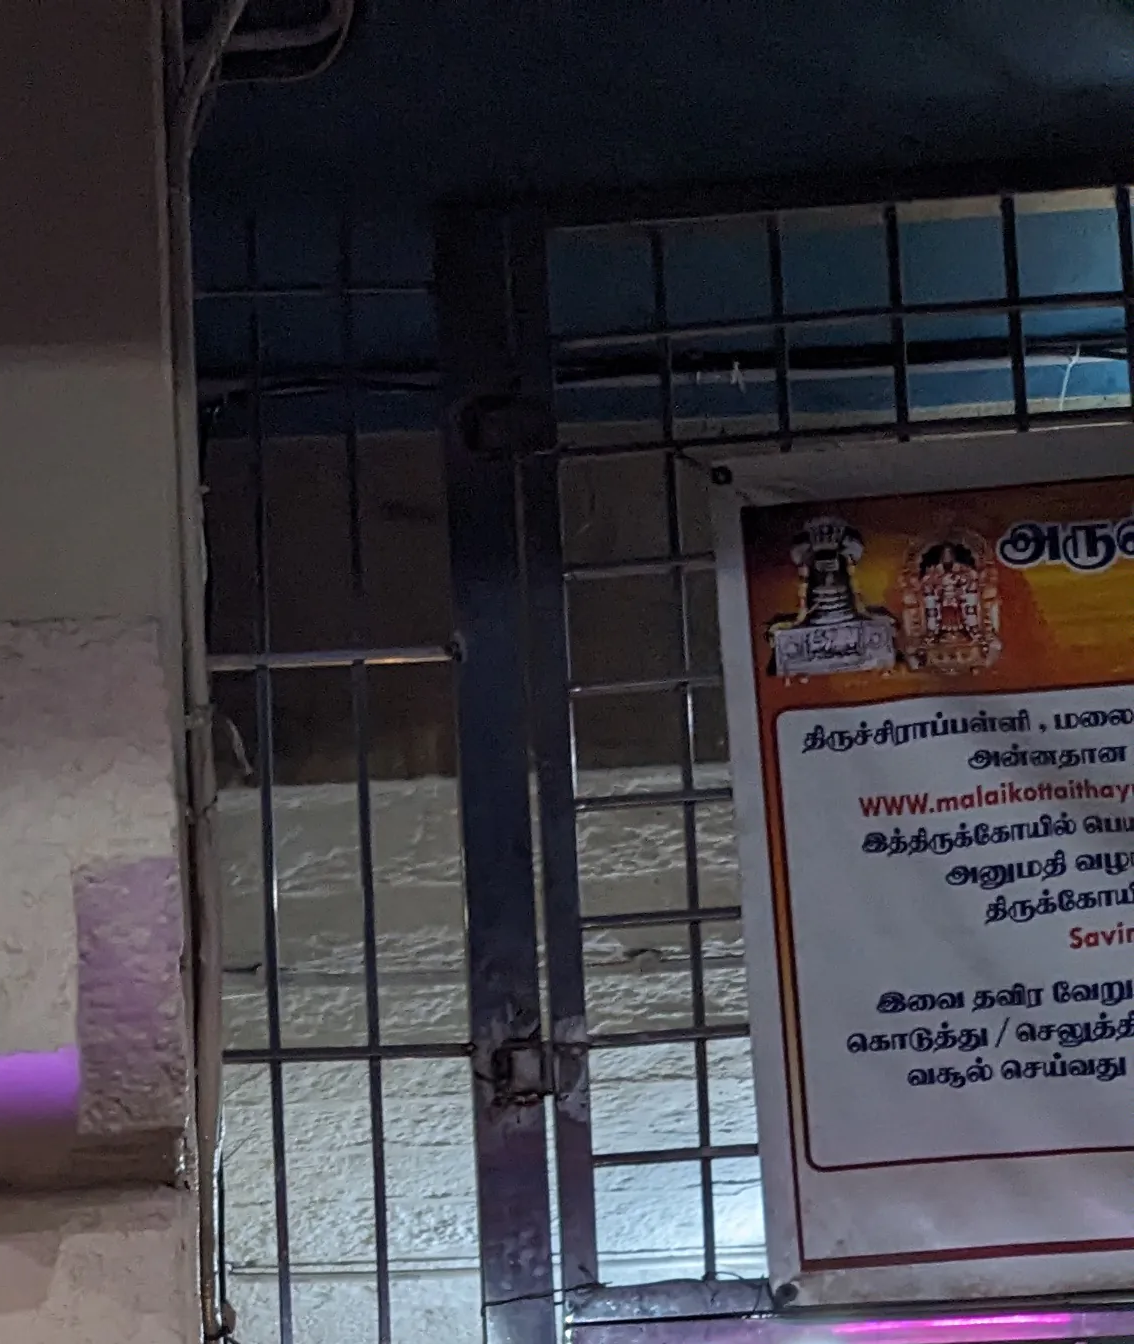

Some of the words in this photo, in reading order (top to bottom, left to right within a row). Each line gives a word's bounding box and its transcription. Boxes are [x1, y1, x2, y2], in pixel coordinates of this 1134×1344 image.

[802, 709, 1031, 752] திருச்சிராப்பள்ளி
[969, 745, 1127, 769] அன்னதான
[862, 812, 1076, 855] இத்திருக்கோயில்
[946, 850, 1066, 890] அனுமதி
[877, 991, 964, 1013] இவை
[972, 984, 1043, 1011] தவிர
[846, 1022, 988, 1053] கொடுத்து
[995, 1017, 1010, 1047] /
[907, 1057, 993, 1088] வசூல்
[1001, 1052, 1126, 1082] செய்வது
